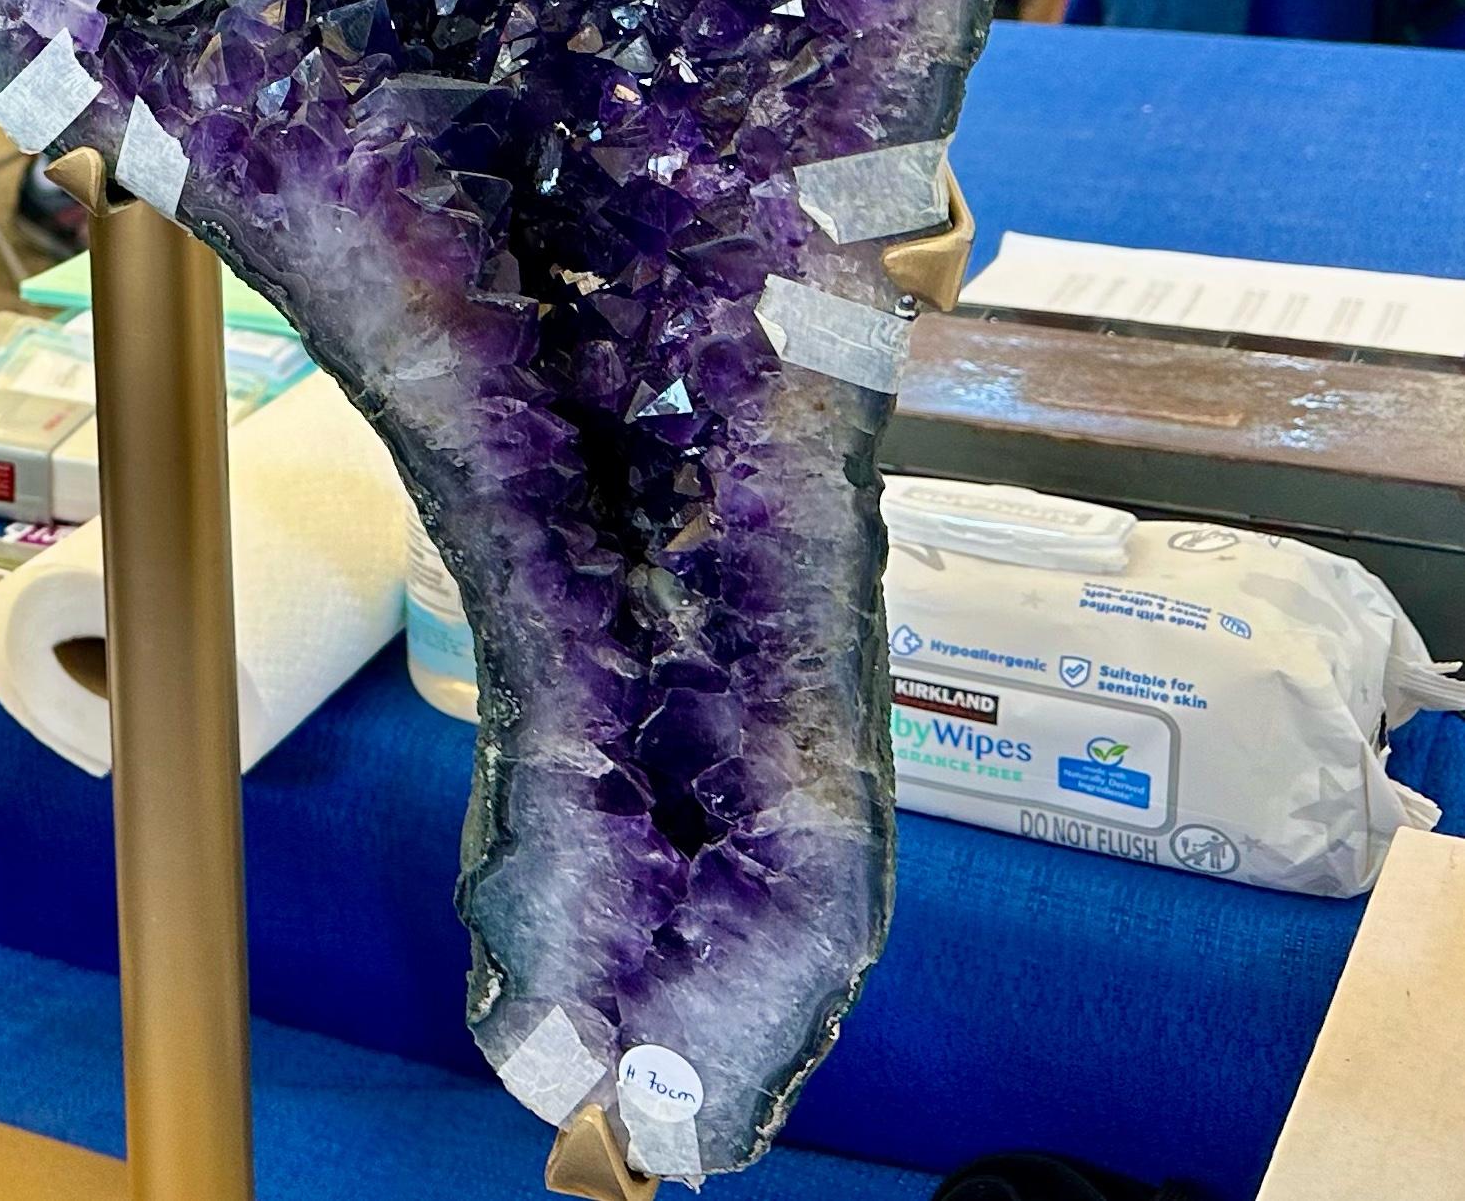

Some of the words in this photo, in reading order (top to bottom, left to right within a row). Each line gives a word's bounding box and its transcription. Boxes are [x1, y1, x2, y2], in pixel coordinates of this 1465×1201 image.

[1079, 598, 1134, 616] purified
[1136, 609, 1165, 623] with
[1168, 615, 1207, 630] Made
[930, 639, 1047, 673] Hypoallergenic
[1099, 664, 1167, 688] Suitable
[1171, 678, 1195, 693] for
[894, 678, 996, 713] KIRKLAND
[1097, 680, 1170, 703] sensitive
[1173, 695, 1208, 709] skin
[893, 708, 1032, 762] byWipes
[897, 748, 970, 773] GRANCE
[976, 764, 1024, 781] FREE
[1108, 778, 1145, 795] Derived
[1020, 809, 1048, 839] DO
[1053, 817, 1092, 847] NOT
[1097, 827, 1158, 863] FLUSH
